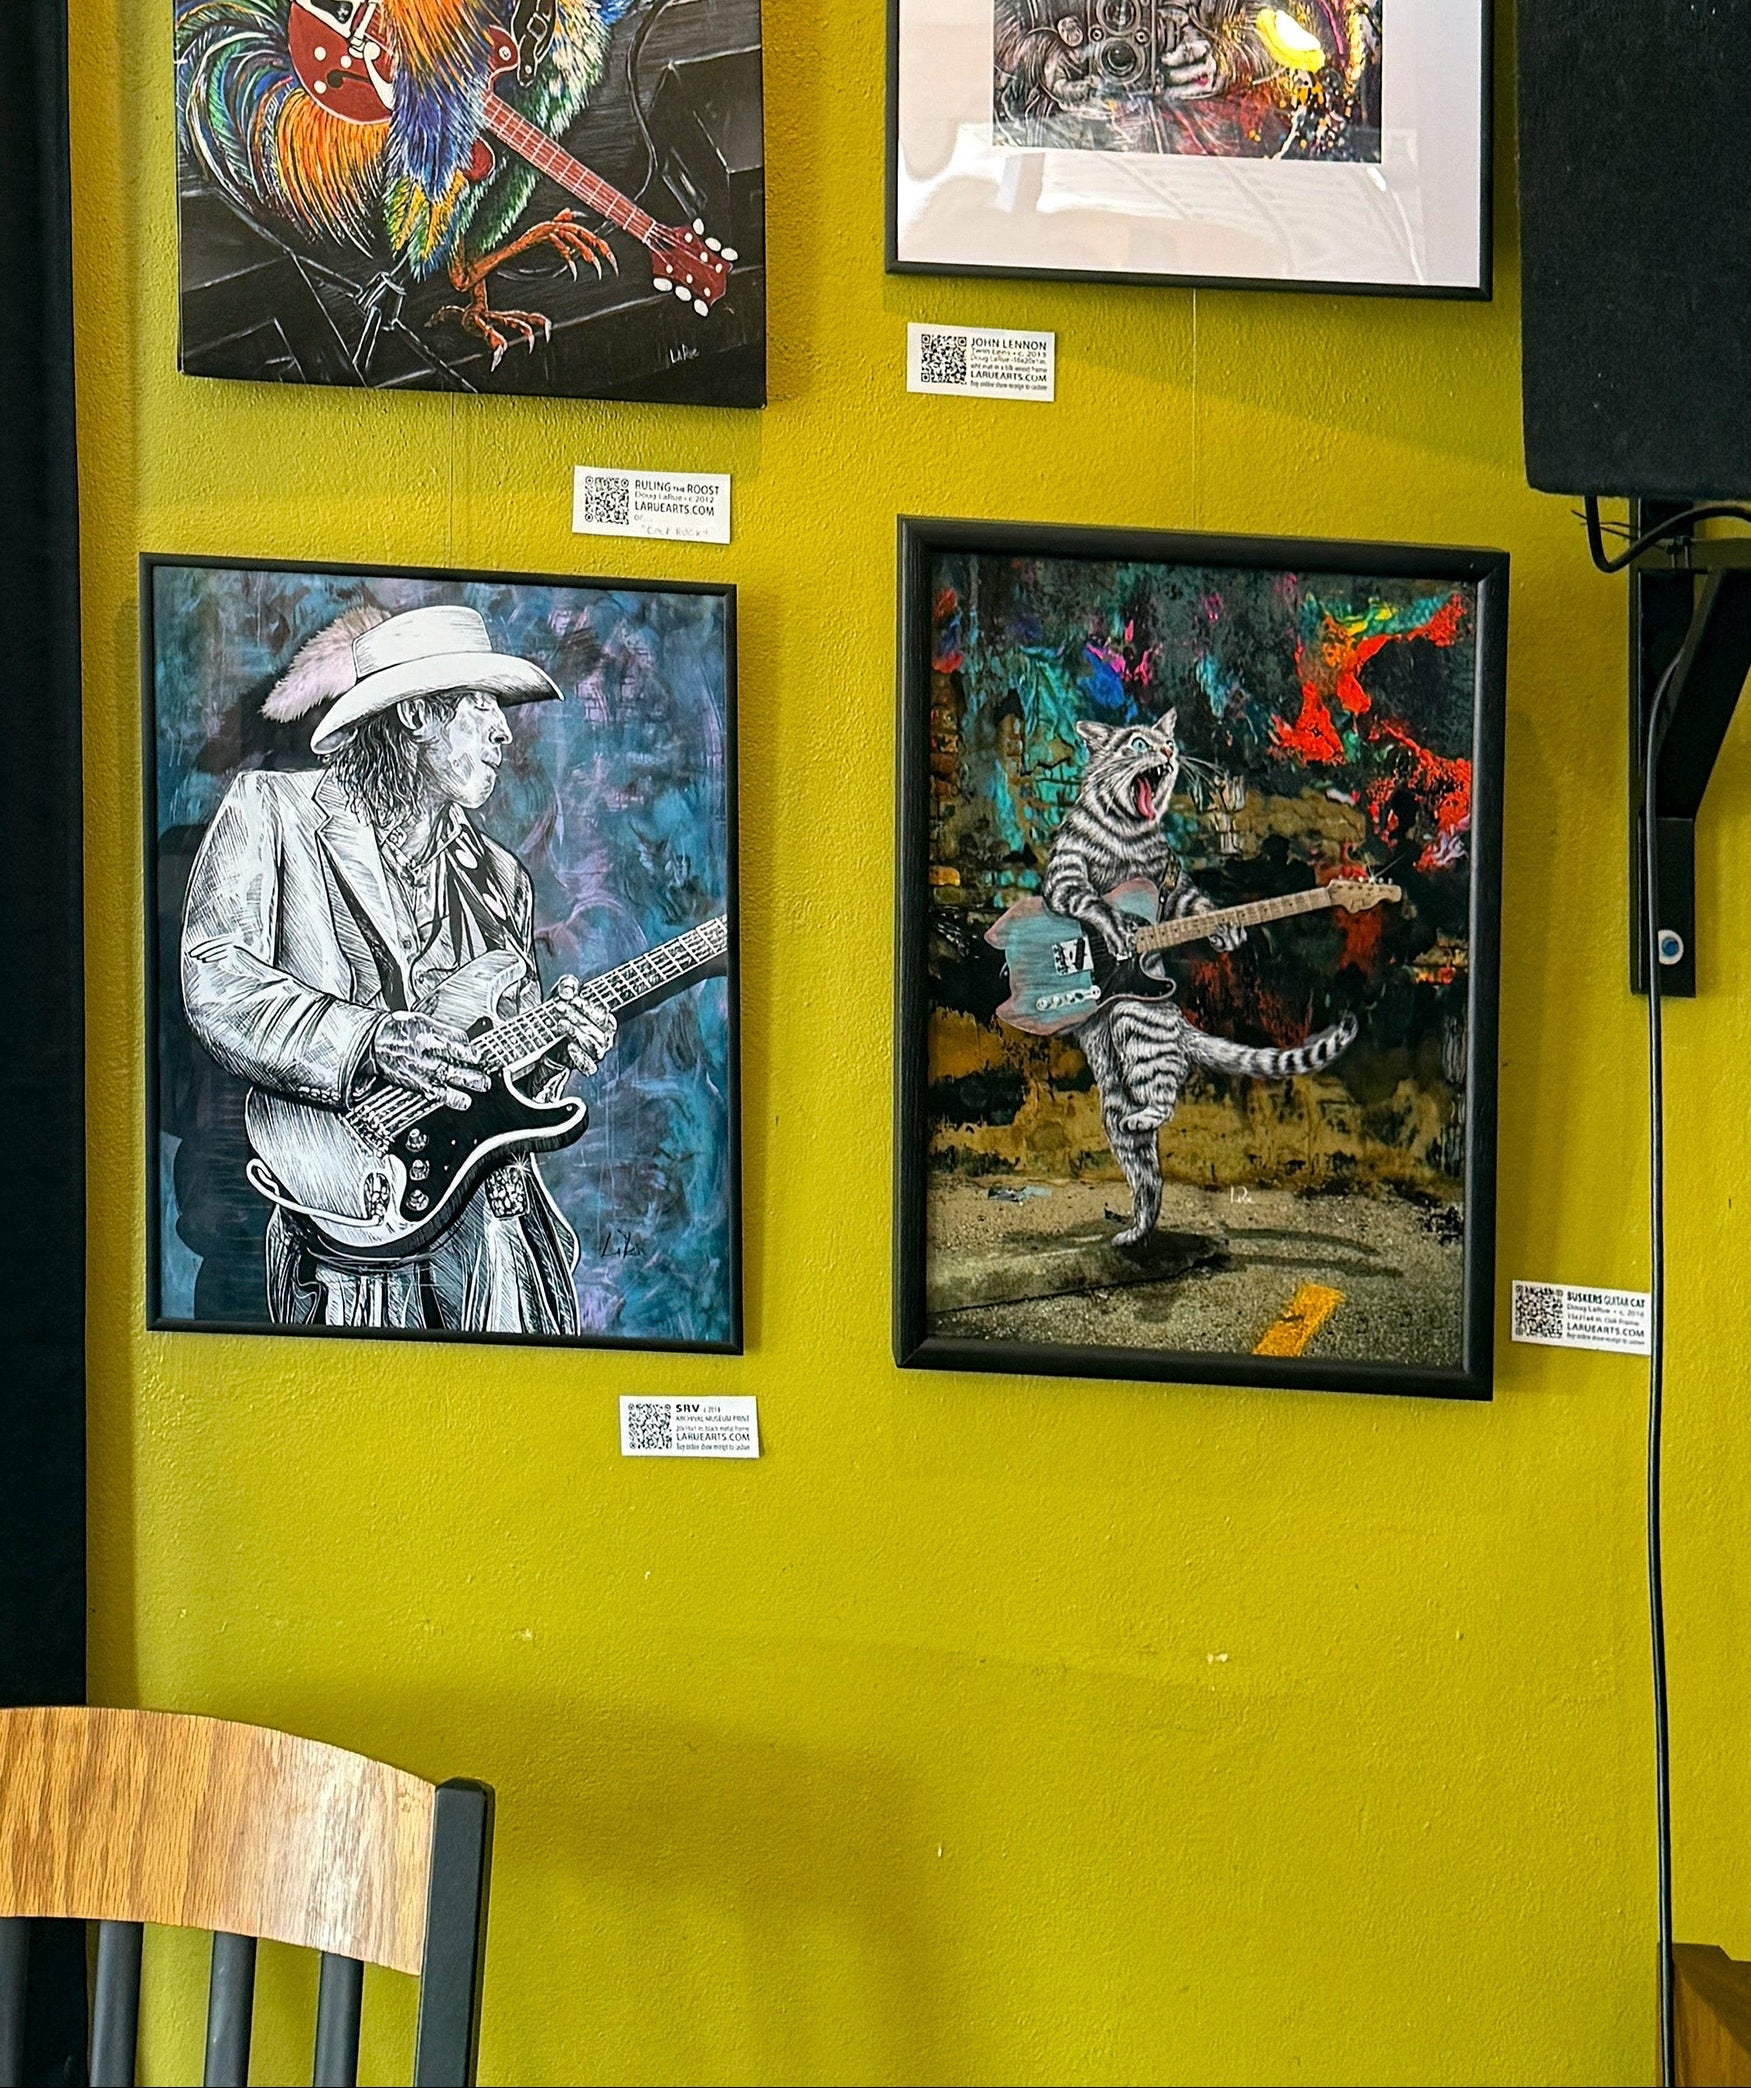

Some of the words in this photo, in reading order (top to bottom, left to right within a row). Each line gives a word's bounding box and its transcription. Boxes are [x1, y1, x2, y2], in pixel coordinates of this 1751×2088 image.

[971, 337, 999, 348] JOHN
[1003, 340, 1047, 350] LENNON
[971, 371, 1047, 382] LARUEARTS.COM
[635, 480, 671, 492] RULING
[687, 483, 720, 495] ROOST
[635, 491, 656, 500] Doug
[695, 496, 714, 504] 2012
[635, 501, 714, 516] LARUEARTS.COM
[1567, 1291, 1602, 1304] BUSKERS
[1604, 1295, 1628, 1306] GUITAR
[1630, 1298, 1646, 1308] CAT
[1567, 1322, 1645, 1337] LARUEARTS.COM
[676, 1404, 700, 1413] SRV
[676, 1433, 750, 1441] LARUEARTS.COM
